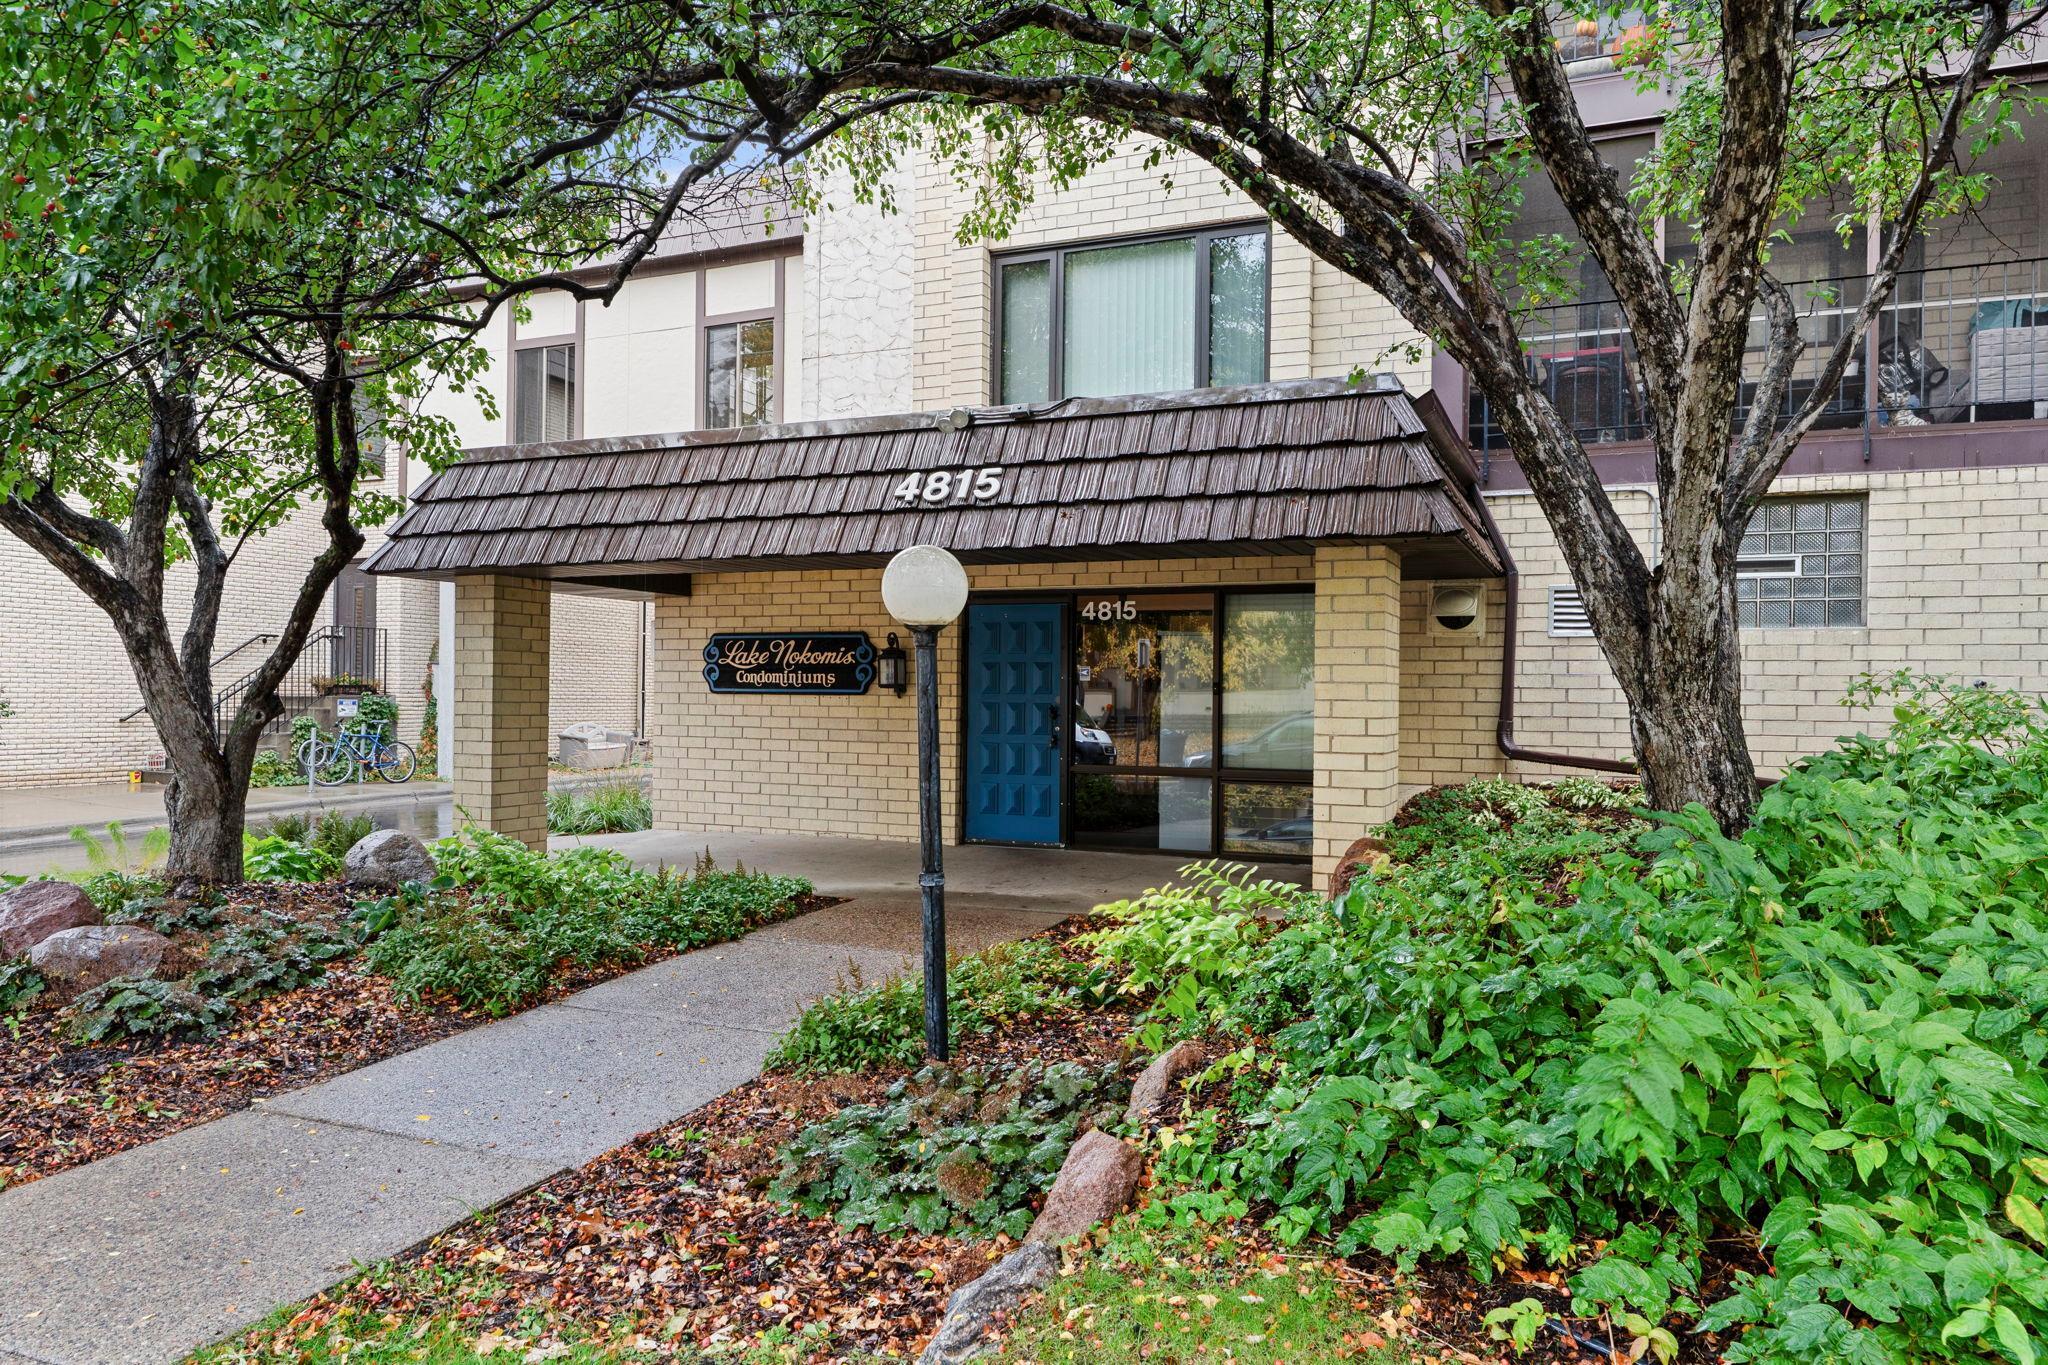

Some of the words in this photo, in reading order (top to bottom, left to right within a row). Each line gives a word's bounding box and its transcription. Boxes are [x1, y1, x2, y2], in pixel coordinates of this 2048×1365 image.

[894, 467, 1003, 502] 4815
[1081, 600, 1137, 621] 4815
[718, 640, 770, 669] Lake
[769, 639, 856, 671] Nokomis
[735, 670, 836, 687] Condominiums
